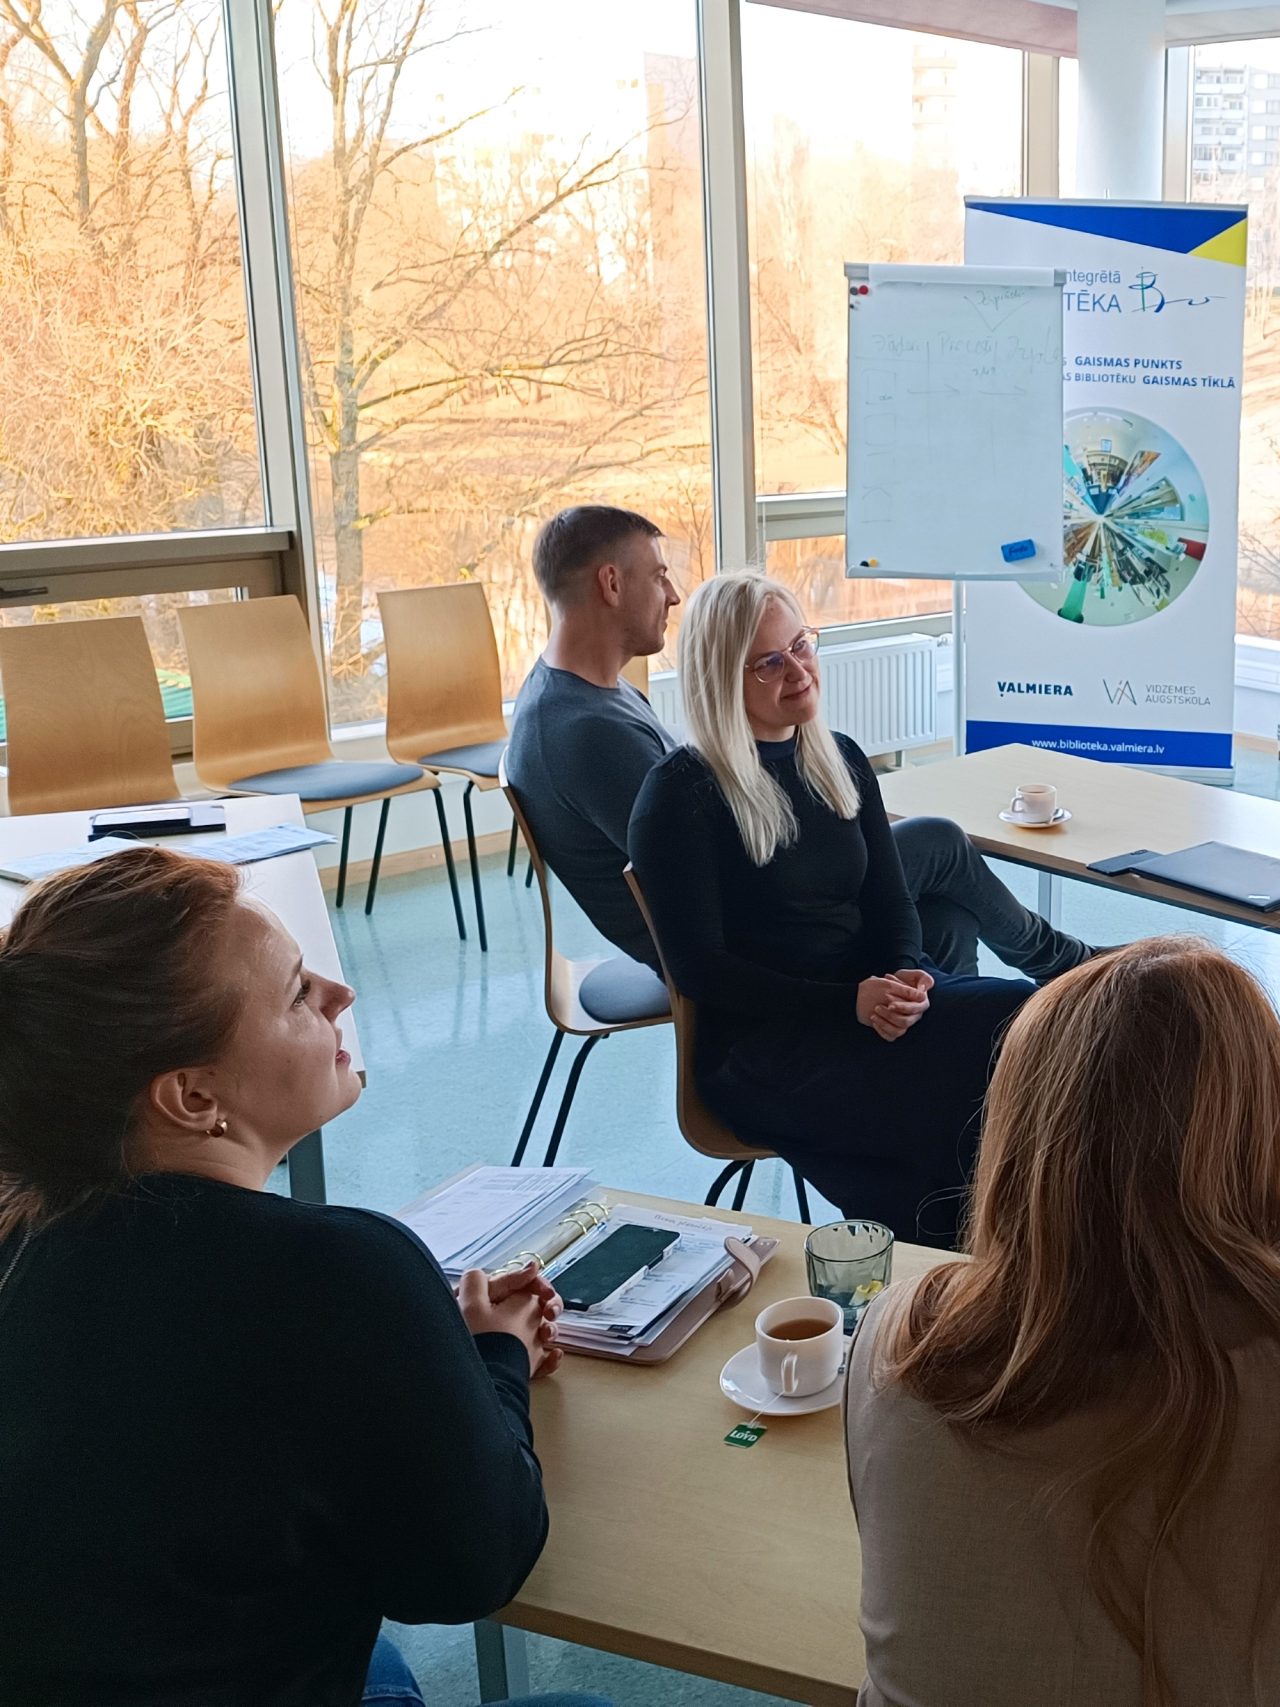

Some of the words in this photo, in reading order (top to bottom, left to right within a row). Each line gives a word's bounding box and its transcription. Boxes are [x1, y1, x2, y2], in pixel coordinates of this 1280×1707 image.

[1065, 269, 1121, 287] ntegrētā
[1063, 289, 1122, 313] TĒKA
[1074, 355, 1130, 368] GAISMAS
[1134, 357, 1183, 370] PUNKTS
[1074, 372, 1137, 384] BIBLIOTĒKU
[1142, 374, 1198, 388] GAISMAS
[1202, 375, 1236, 389] TĪKLĀ
[997, 681, 1074, 698] VALMIERA
[1145, 684, 1197, 696] VIDZEMES
[1144, 695, 1211, 706] AUGSTSKOLA
[1031, 738, 1165, 755] www.biblioteka.valmiera.lv
[729, 1430, 758, 1442] LOYD
